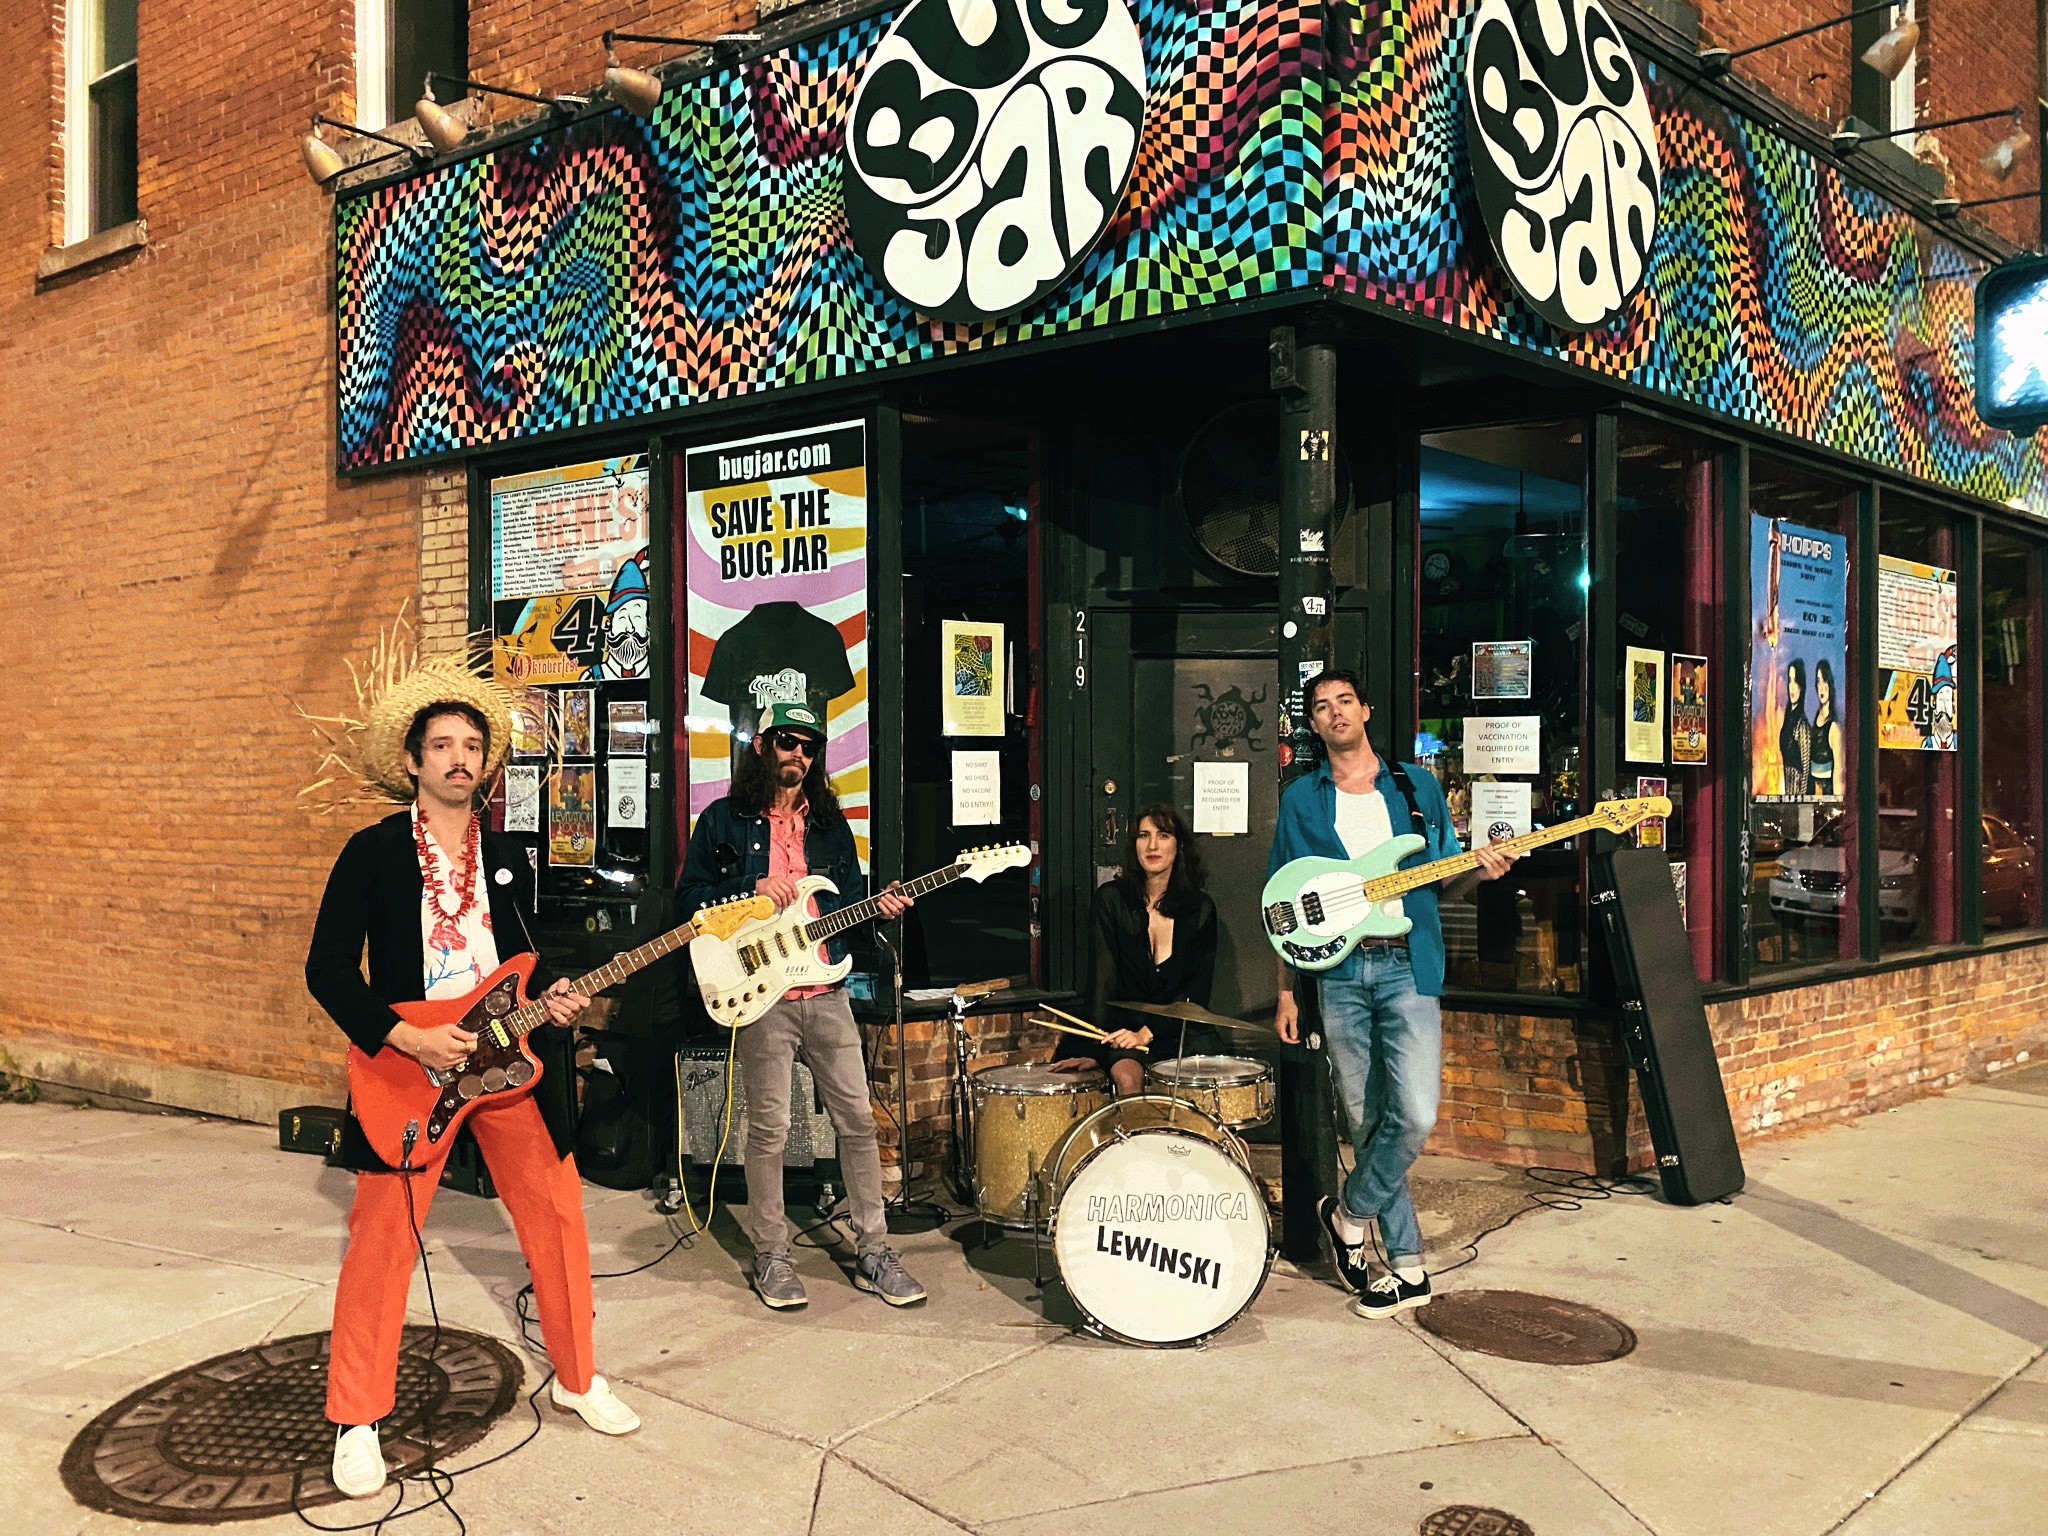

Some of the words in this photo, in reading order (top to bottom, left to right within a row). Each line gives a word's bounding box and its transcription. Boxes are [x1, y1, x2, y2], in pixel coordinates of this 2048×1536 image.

[719, 442, 831, 481] bugjar.com
[711, 495, 774, 539] SAVE
[780, 488, 831, 530] THE
[721, 539, 774, 580] BUG
[781, 534, 828, 574] JAR
[1781, 533, 1833, 561] KOPPS
[1478, 733, 1528, 741] VACCINATION
[1511, 721, 1522, 729] OF
[1087, 1193, 1248, 1223] HARMONICA
[1097, 1225, 1221, 1290] LEWINSKI
